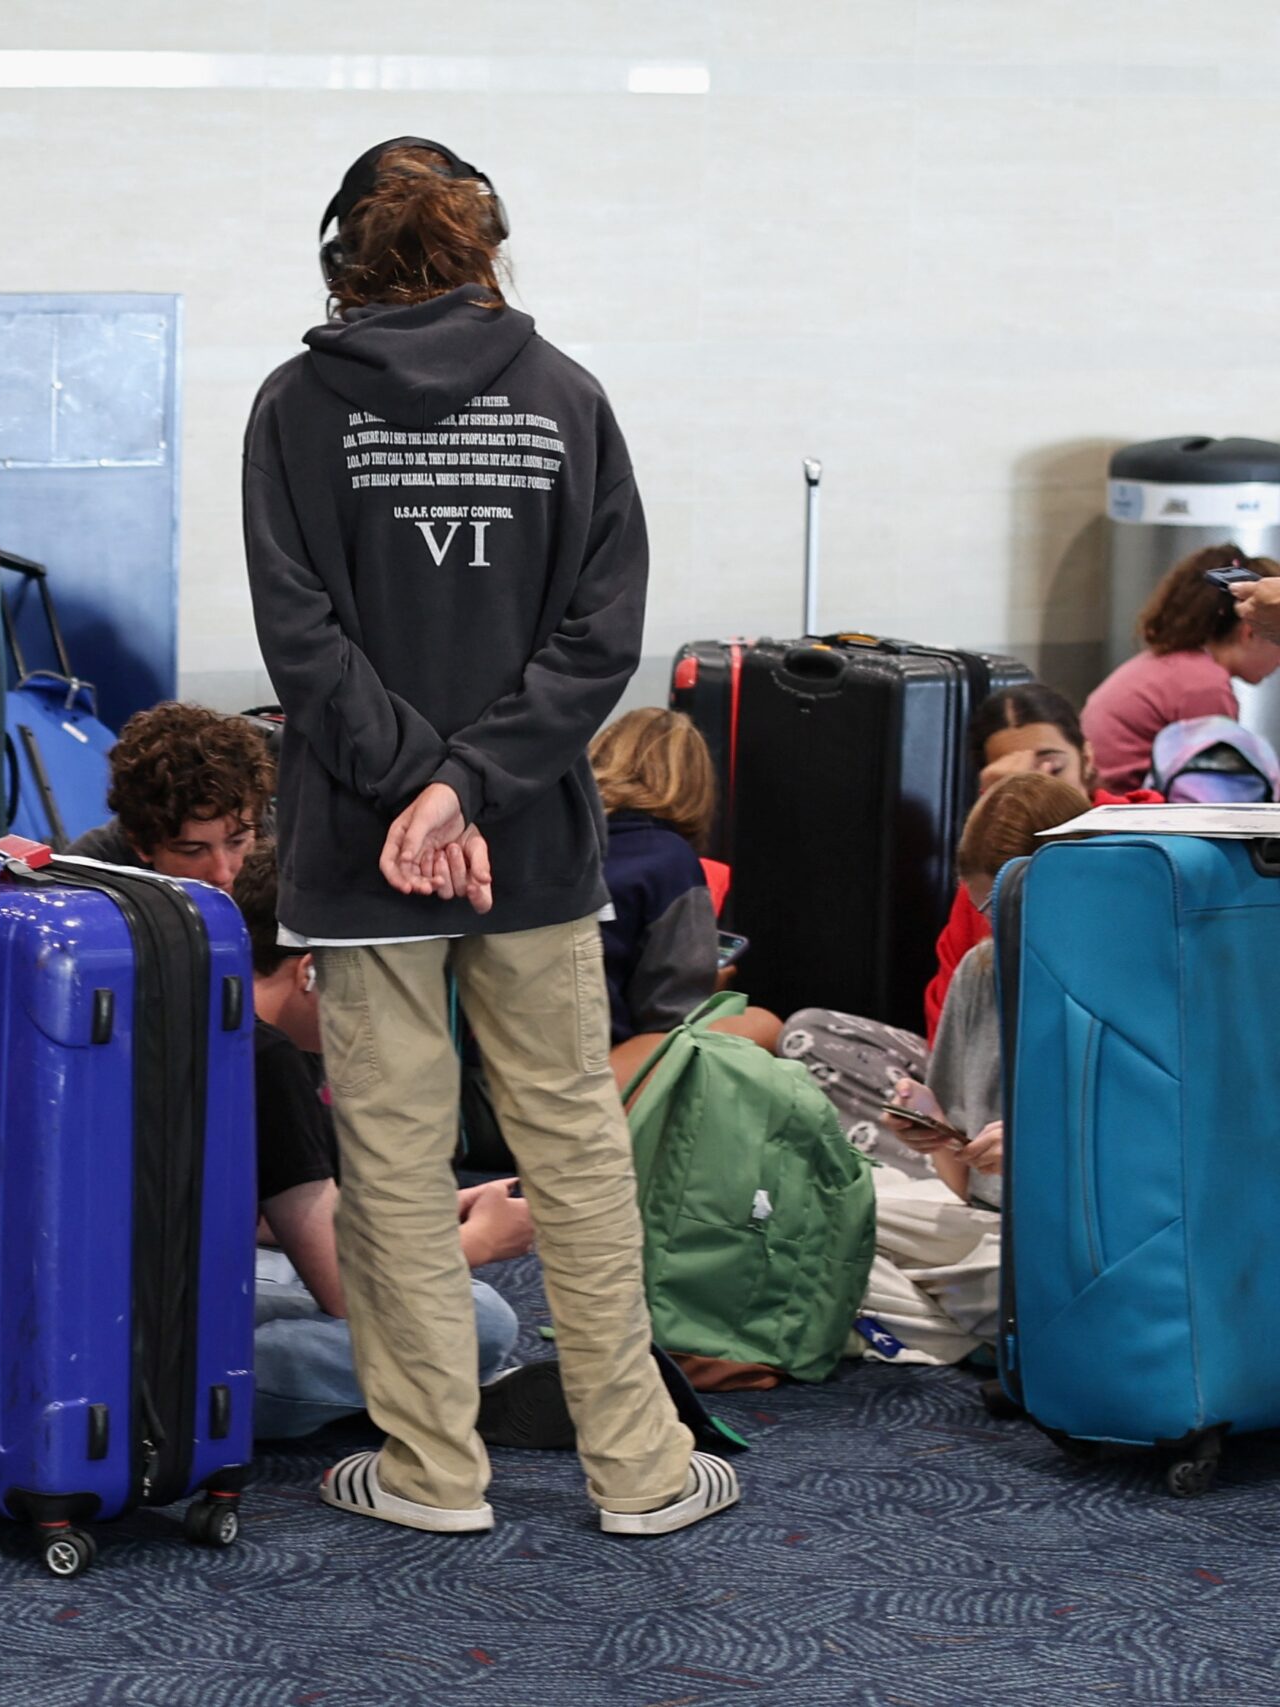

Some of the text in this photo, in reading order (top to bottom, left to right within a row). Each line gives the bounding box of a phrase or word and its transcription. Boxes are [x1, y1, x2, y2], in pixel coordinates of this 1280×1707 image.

[458, 414, 469, 426] MY
[469, 414, 498, 426] SISTERS
[499, 414, 513, 426] AND
[514, 413, 525, 426] MY
[357, 430, 380, 445] THERE
[380, 431, 389, 444] DO
[393, 431, 407, 445] SEE
[407, 432, 421, 445] THE
[422, 432, 438, 445] LINE
[439, 432, 449, 445] OF
[449, 432, 460, 445] MY
[460, 433, 487, 446] PEOPLE
[488, 433, 506, 446] BACK
[506, 433, 516, 446] TO
[517, 433, 531, 446] THE
[361, 452, 370, 466] DO
[370, 452, 387, 465] THEY
[387, 452, 404, 465] CALL
[404, 452, 414, 465] TO
[414, 452, 428, 466] ME,
[428, 452, 446, 465] THEY
[446, 452, 459, 465] BID
[459, 452, 470, 465] ME
[471, 453, 489, 466] TAKE
[489, 453, 500, 466] MY
[500, 454, 521, 467] PLACE
[371, 473, 390, 487] HALLS
[390, 473, 400, 486] OF
[401, 473, 435, 487] VALHALLA,
[435, 473, 460, 486] WHERE
[460, 473, 474, 486] THE
[475, 473, 496, 486] BRAVE
[497, 474, 511, 487] MAY
[511, 474, 527, 488] LIVE
[393, 506, 514, 519] U.S.A.F. COMBAT CONTROL
[414, 521, 491, 566] VI
